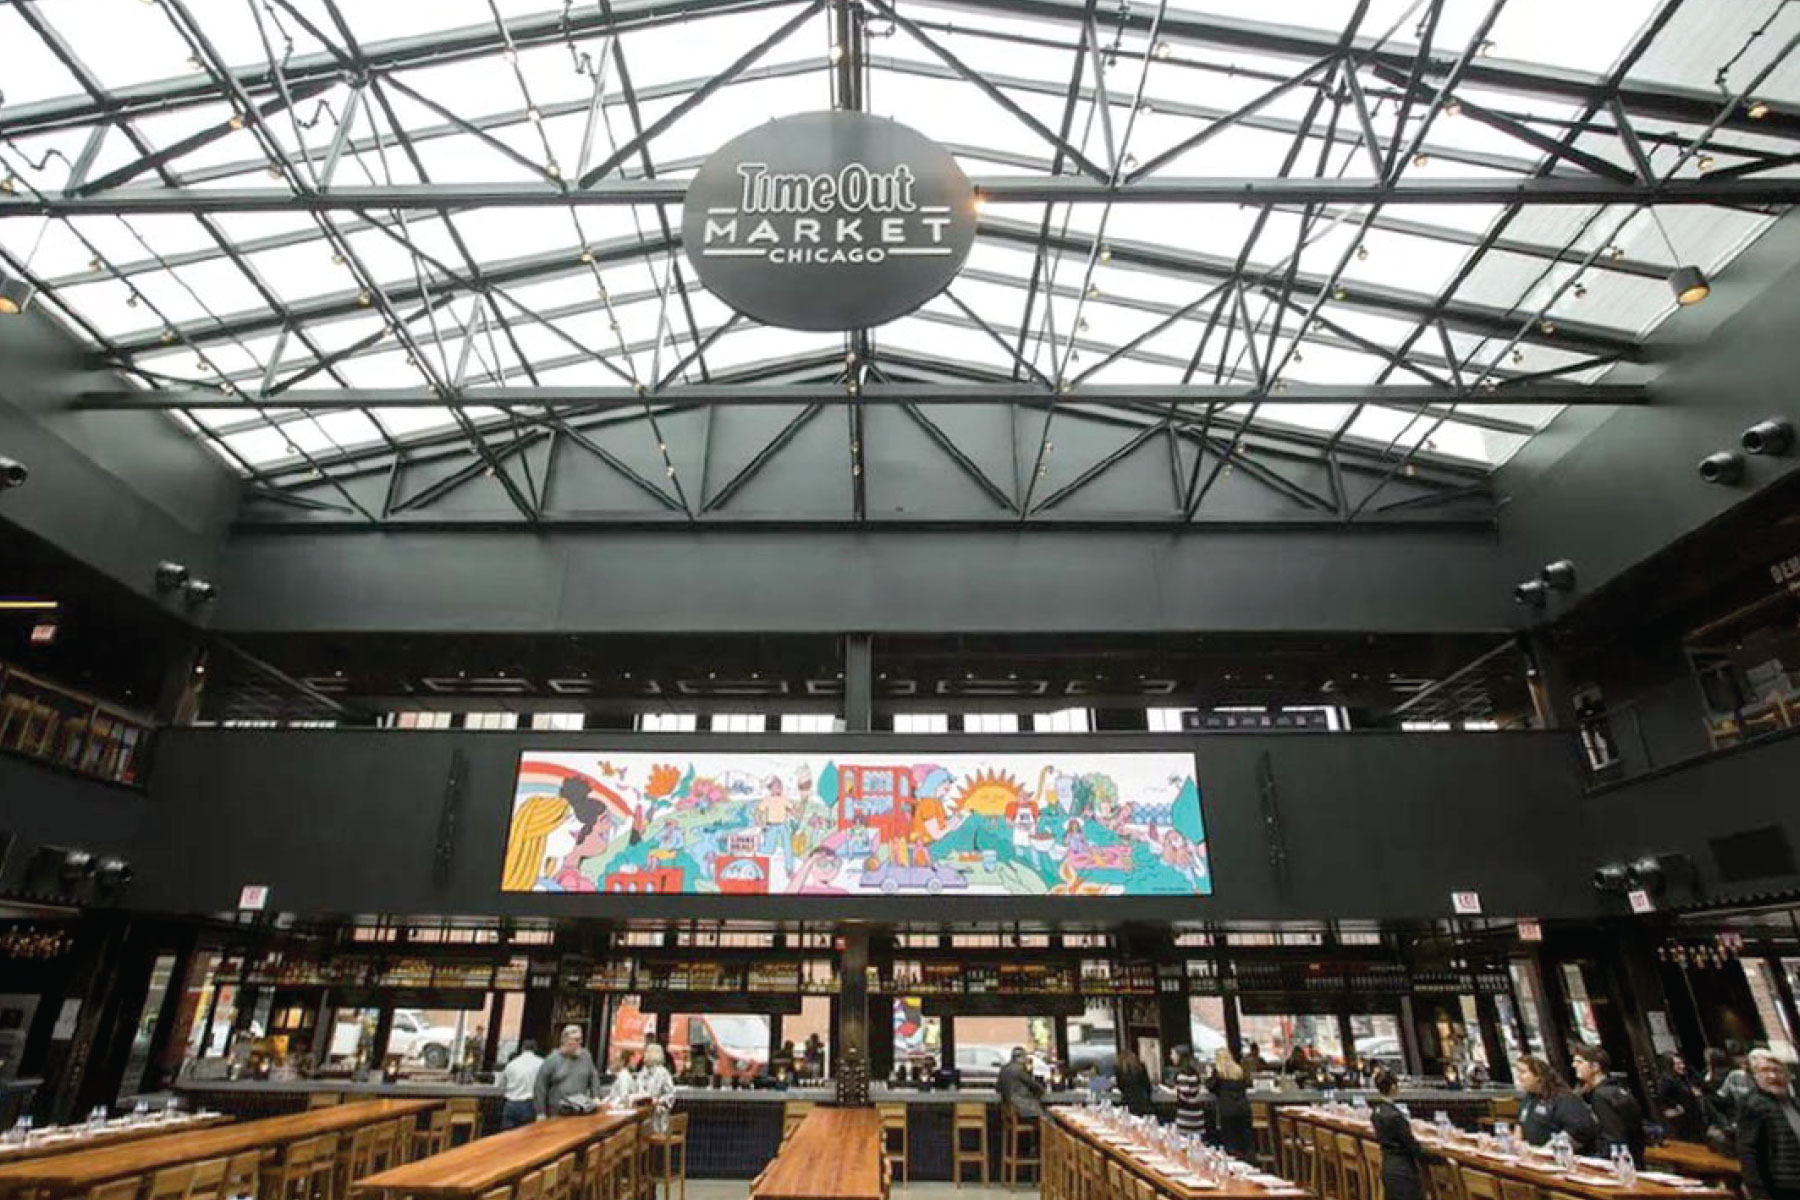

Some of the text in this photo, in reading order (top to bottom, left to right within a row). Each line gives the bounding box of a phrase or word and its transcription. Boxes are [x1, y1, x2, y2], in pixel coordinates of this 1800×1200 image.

[737, 163, 916, 213] Time Out
[703, 218, 951, 243] MARKET
[769, 248, 885, 263] CHICAGO
